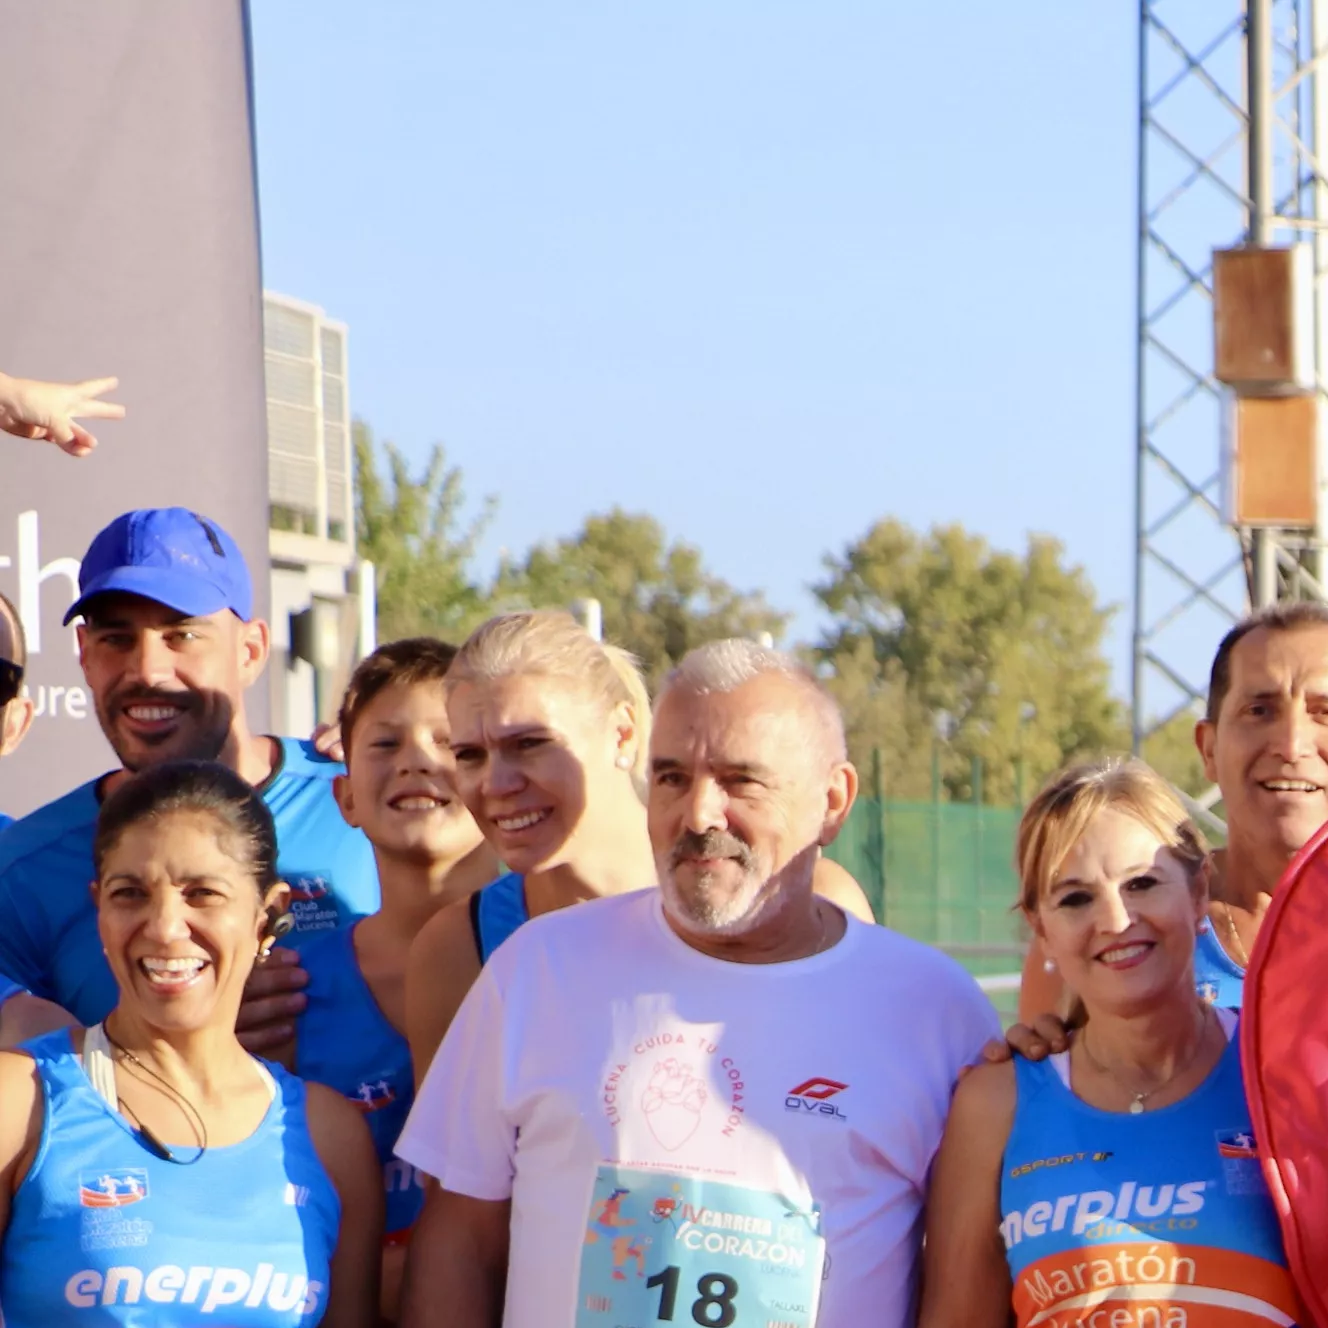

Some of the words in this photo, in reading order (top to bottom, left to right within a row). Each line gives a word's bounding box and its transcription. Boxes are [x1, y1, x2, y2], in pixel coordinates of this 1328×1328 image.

[604, 1063, 627, 1127] LUCENA
[634, 1033, 685, 1055] CUIDA
[698, 1038, 719, 1055] TU
[682, 1203, 706, 1224] IV
[702, 1209, 772, 1236] CARRERA
[999, 1180, 1208, 1249] nerplus
[1085, 1217, 1198, 1240] directo
[64, 1262, 325, 1314] enerplus
[1024, 1245, 1197, 1310] Maratón
